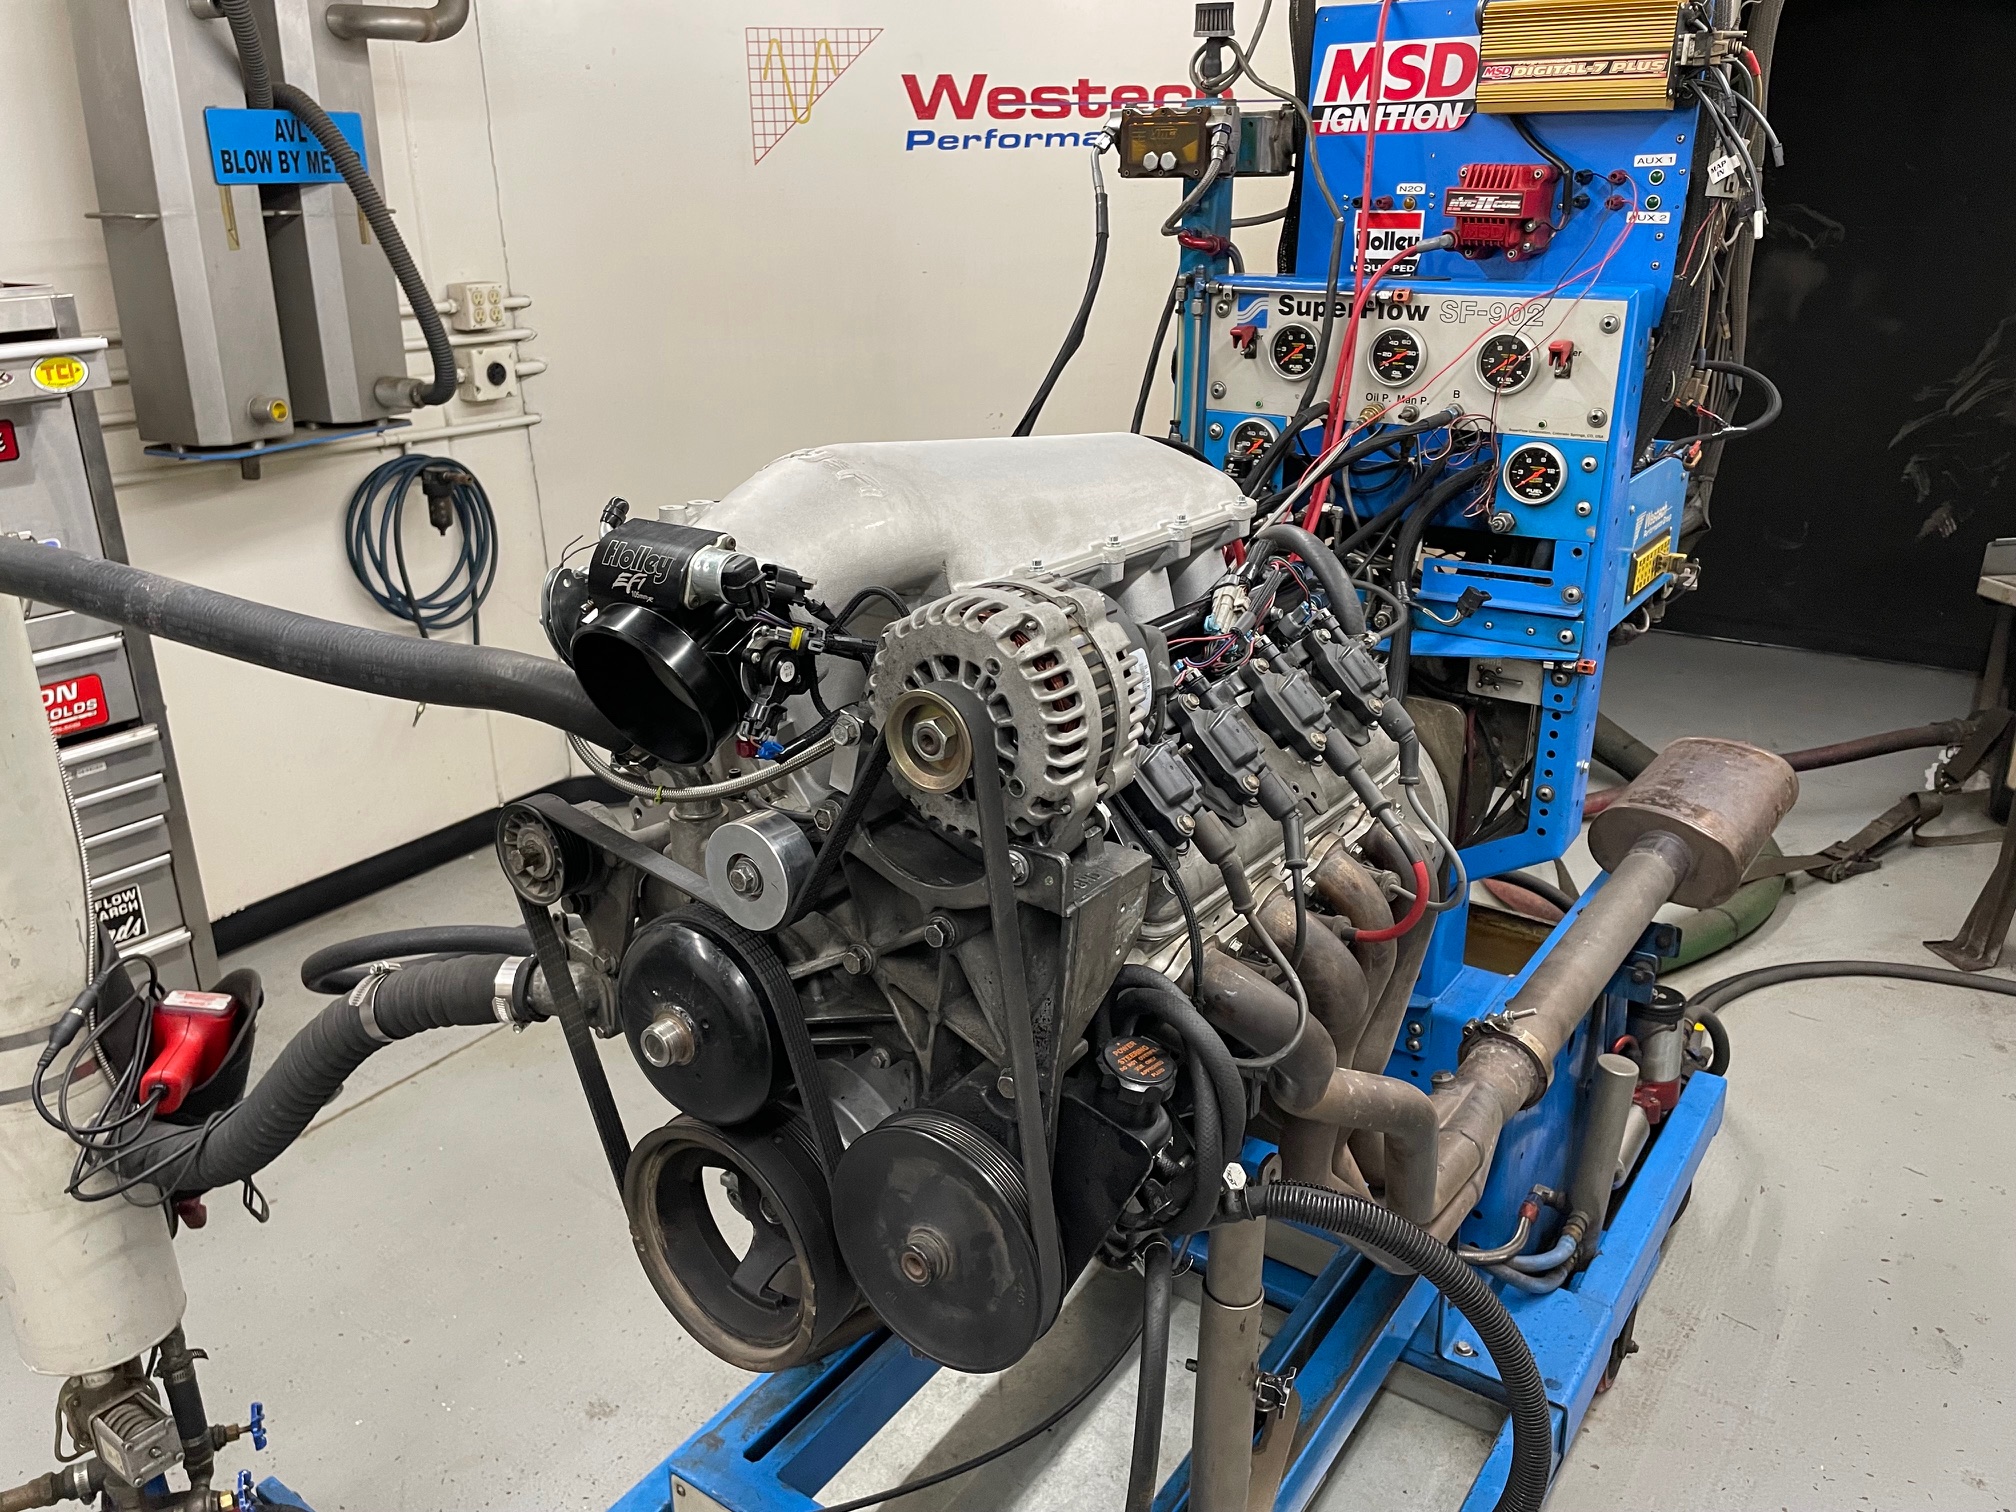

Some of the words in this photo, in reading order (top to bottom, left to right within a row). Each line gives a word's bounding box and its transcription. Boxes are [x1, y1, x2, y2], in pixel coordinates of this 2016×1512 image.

[1324, 42, 1479, 103] MSD
[1483, 65, 1512, 79] MSD
[1511, 62, 1609, 79] DIGITAL-7
[1609, 59, 1667, 74] PLUS
[901, 73, 1234, 120] Westec
[1320, 103, 1464, 134] IGNITION
[275, 119, 308, 143] AVL
[906, 129, 1101, 151] Performa
[221, 150, 272, 174] BLOW
[278, 151, 301, 174] BY
[1636, 157, 1663, 165] AUX
[1710, 160, 1727, 174] MAP
[1716, 169, 1725, 178] IN
[1399, 185, 1424, 193] N2O
[1659, 214, 1667, 222] 2
[1439, 300, 1546, 327] SF-902
[40, 363, 75, 381] TCI
[1365, 392, 1380, 402] Oil
[1382, 393, 1392, 403] P.
[1397, 394, 1417, 405] Man
[1420, 396, 1430, 406] P.
[1453, 389, 1461, 399] B
[602, 539, 676, 585] Holley
[41, 682, 78, 707] ON
[50, 698, 98, 720] OLDS
[99, 899, 139, 922] ARCH
[1112, 1040, 1137, 1057] POWER
[1117, 1044, 1150, 1065] STEERING
